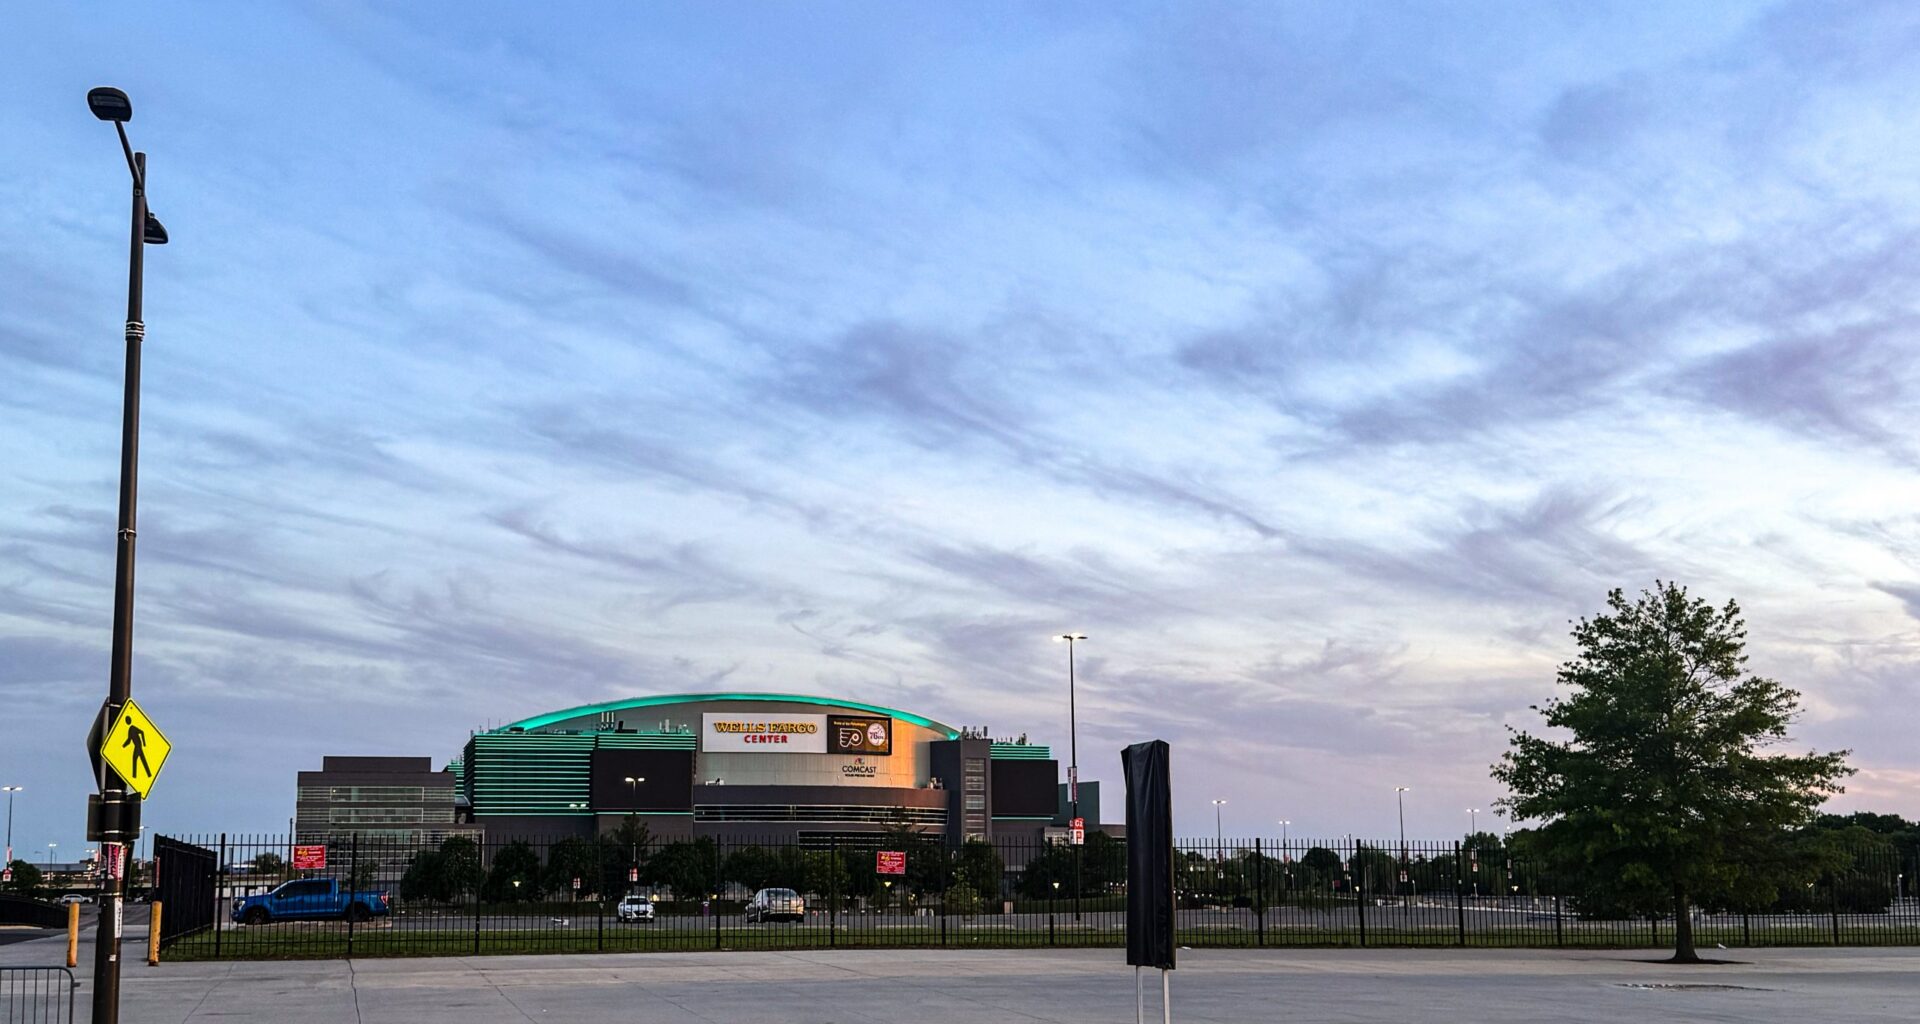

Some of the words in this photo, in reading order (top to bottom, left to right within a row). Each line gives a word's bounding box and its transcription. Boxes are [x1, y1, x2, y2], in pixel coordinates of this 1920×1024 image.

[714, 722, 766, 734] WELLS
[768, 722, 818, 734] FARGO
[744, 735, 788, 743] CENTER
[841, 765, 877, 774] COMCAST
